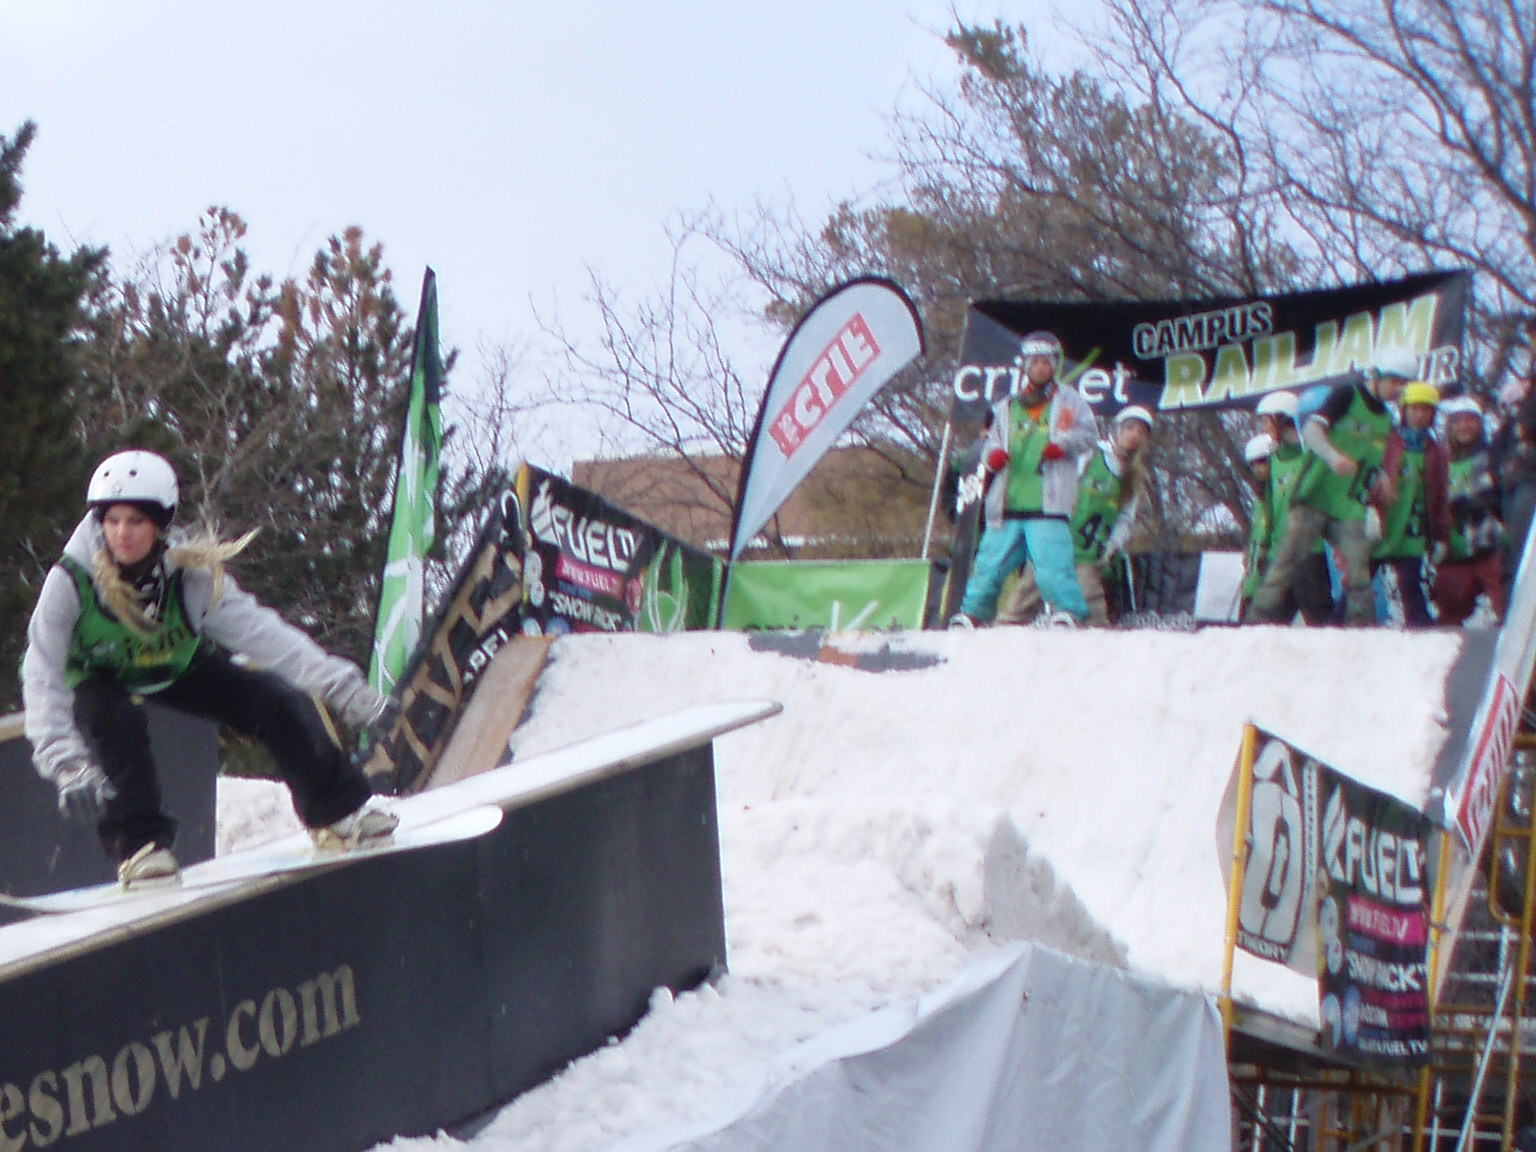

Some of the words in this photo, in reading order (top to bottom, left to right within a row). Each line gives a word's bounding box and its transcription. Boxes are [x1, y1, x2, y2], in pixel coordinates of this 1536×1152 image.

[1131, 301, 1273, 360] CAMPUS
[1157, 292, 1438, 410] RAILJAM
[953, 345, 1135, 405] criet
